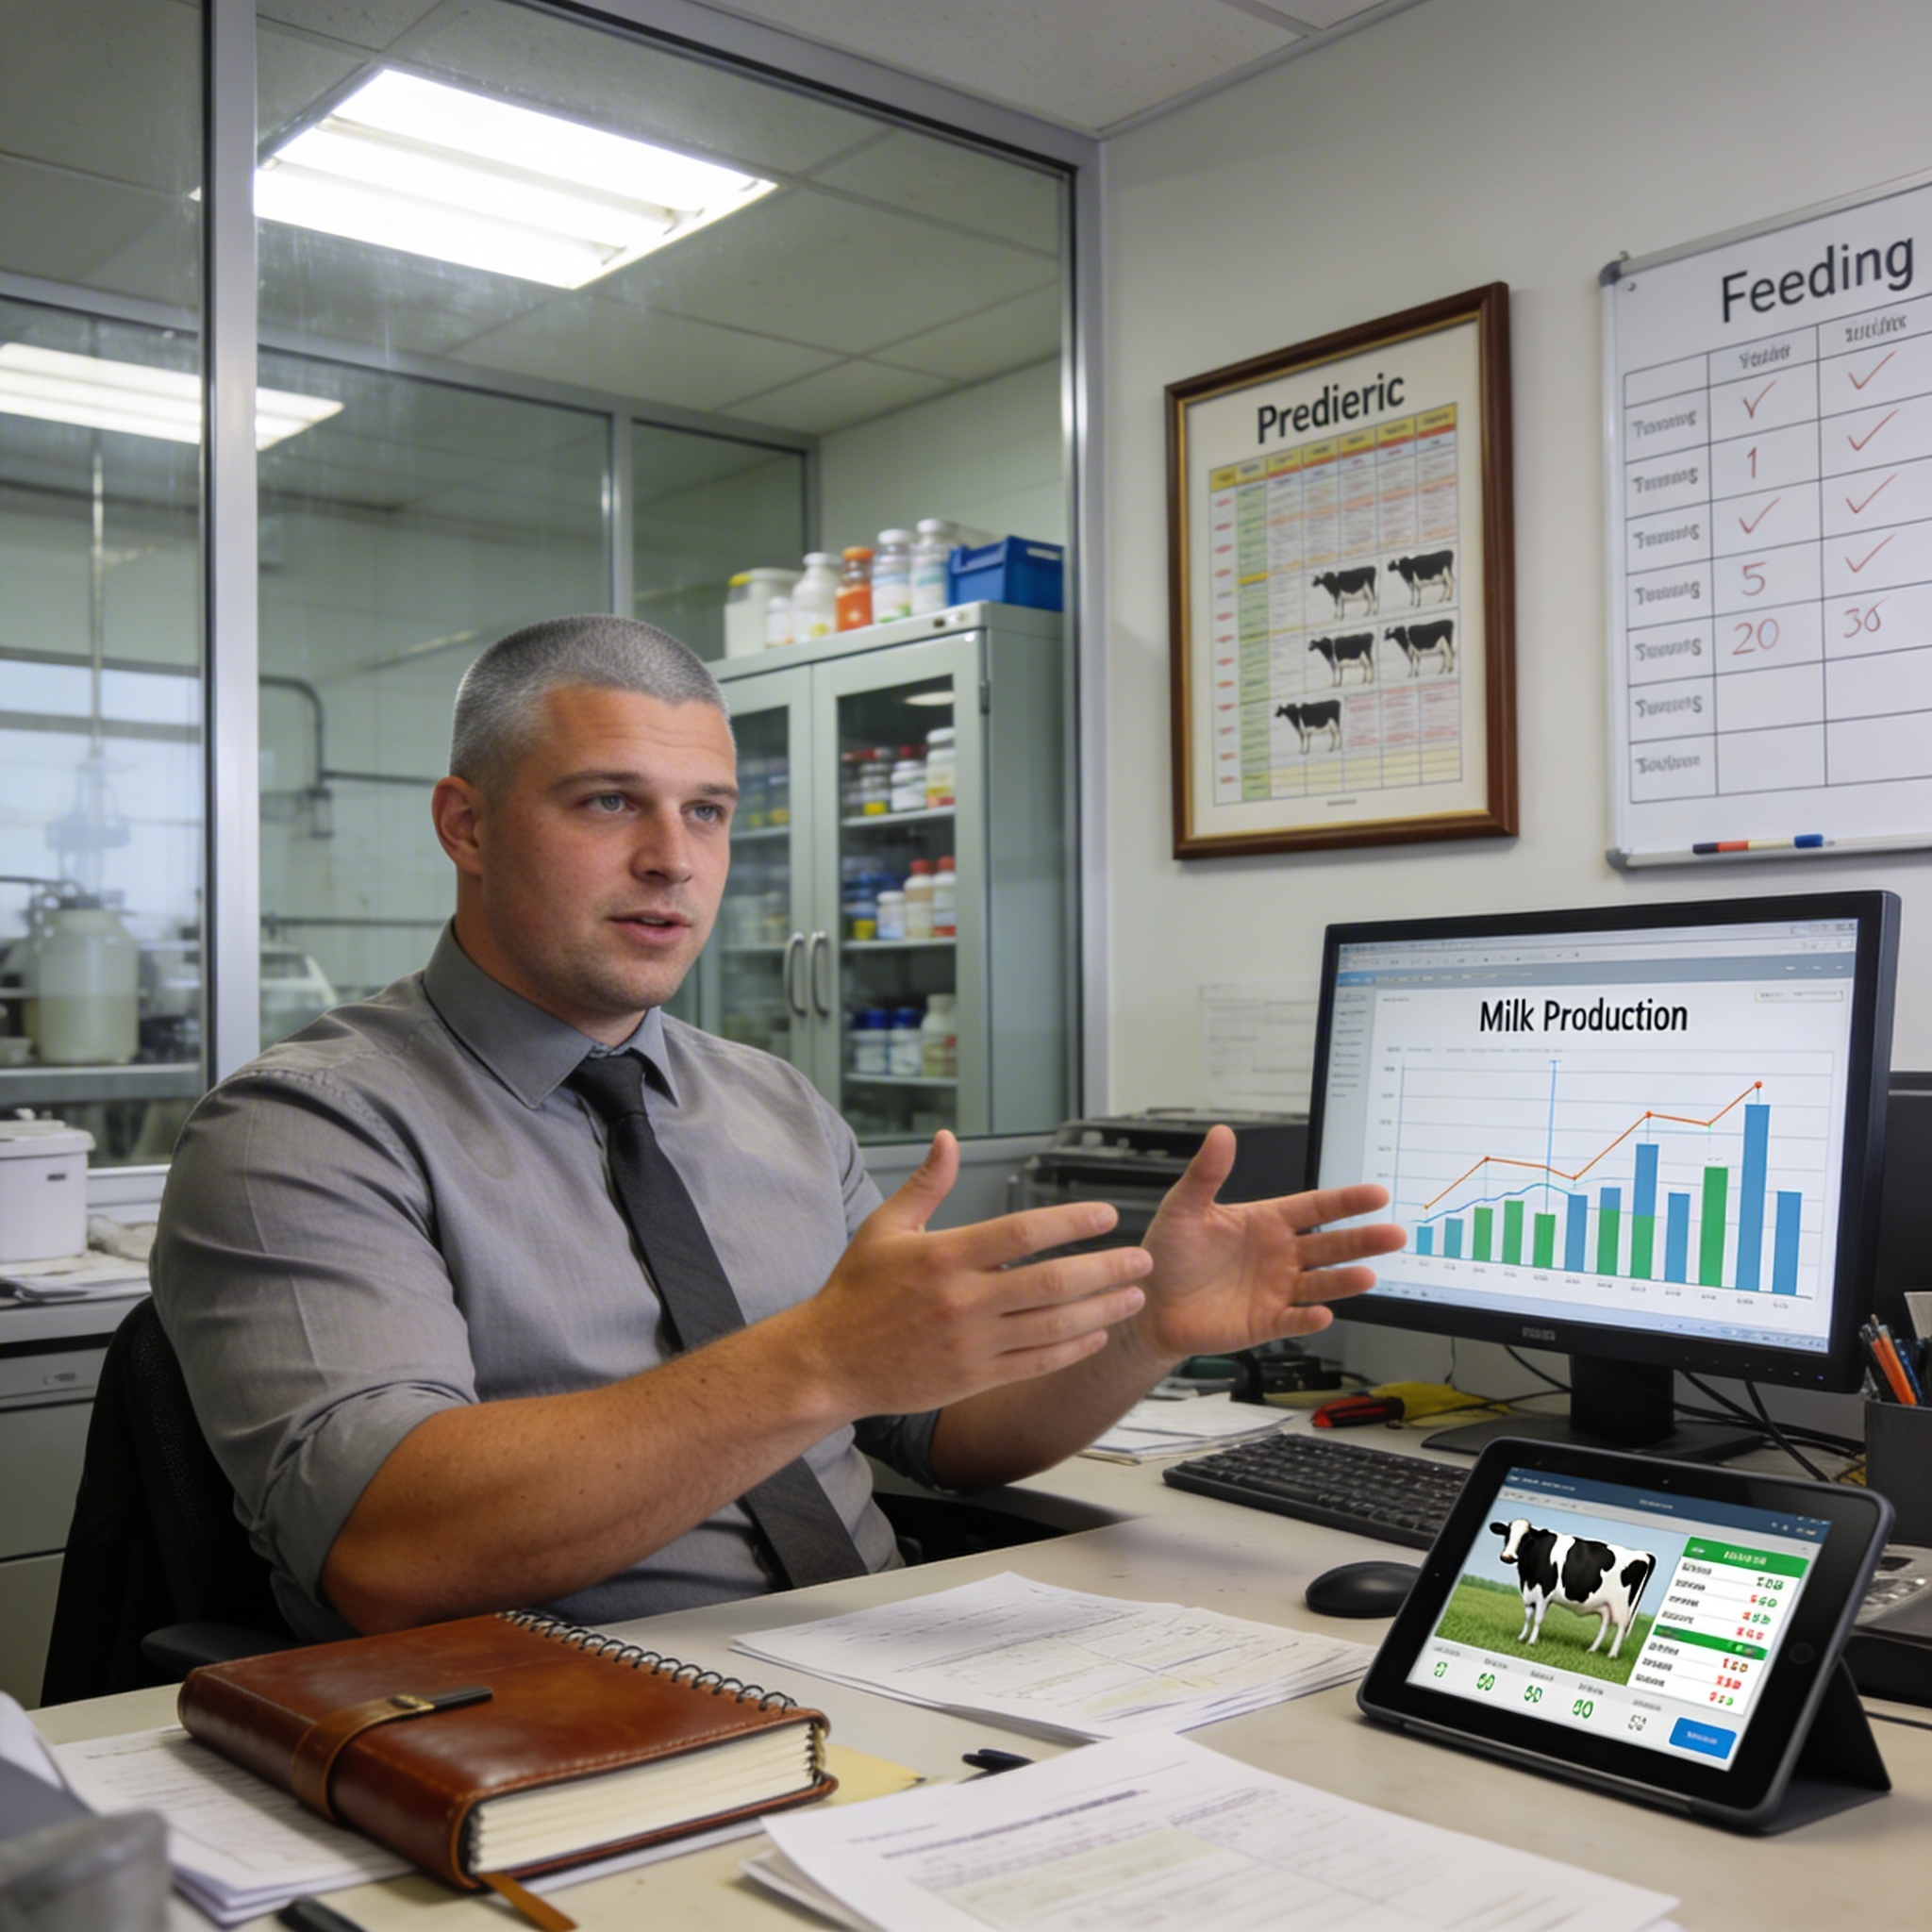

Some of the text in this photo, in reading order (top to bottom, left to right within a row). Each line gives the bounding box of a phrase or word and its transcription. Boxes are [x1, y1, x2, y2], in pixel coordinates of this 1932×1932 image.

[1722, 238, 1913, 323] Feeding
[1257, 373, 1405, 444] Predieric
[1741, 561, 1767, 596] 5
[1732, 618, 1780, 656] 20
[1480, 997, 1688, 1032] Milk Production
